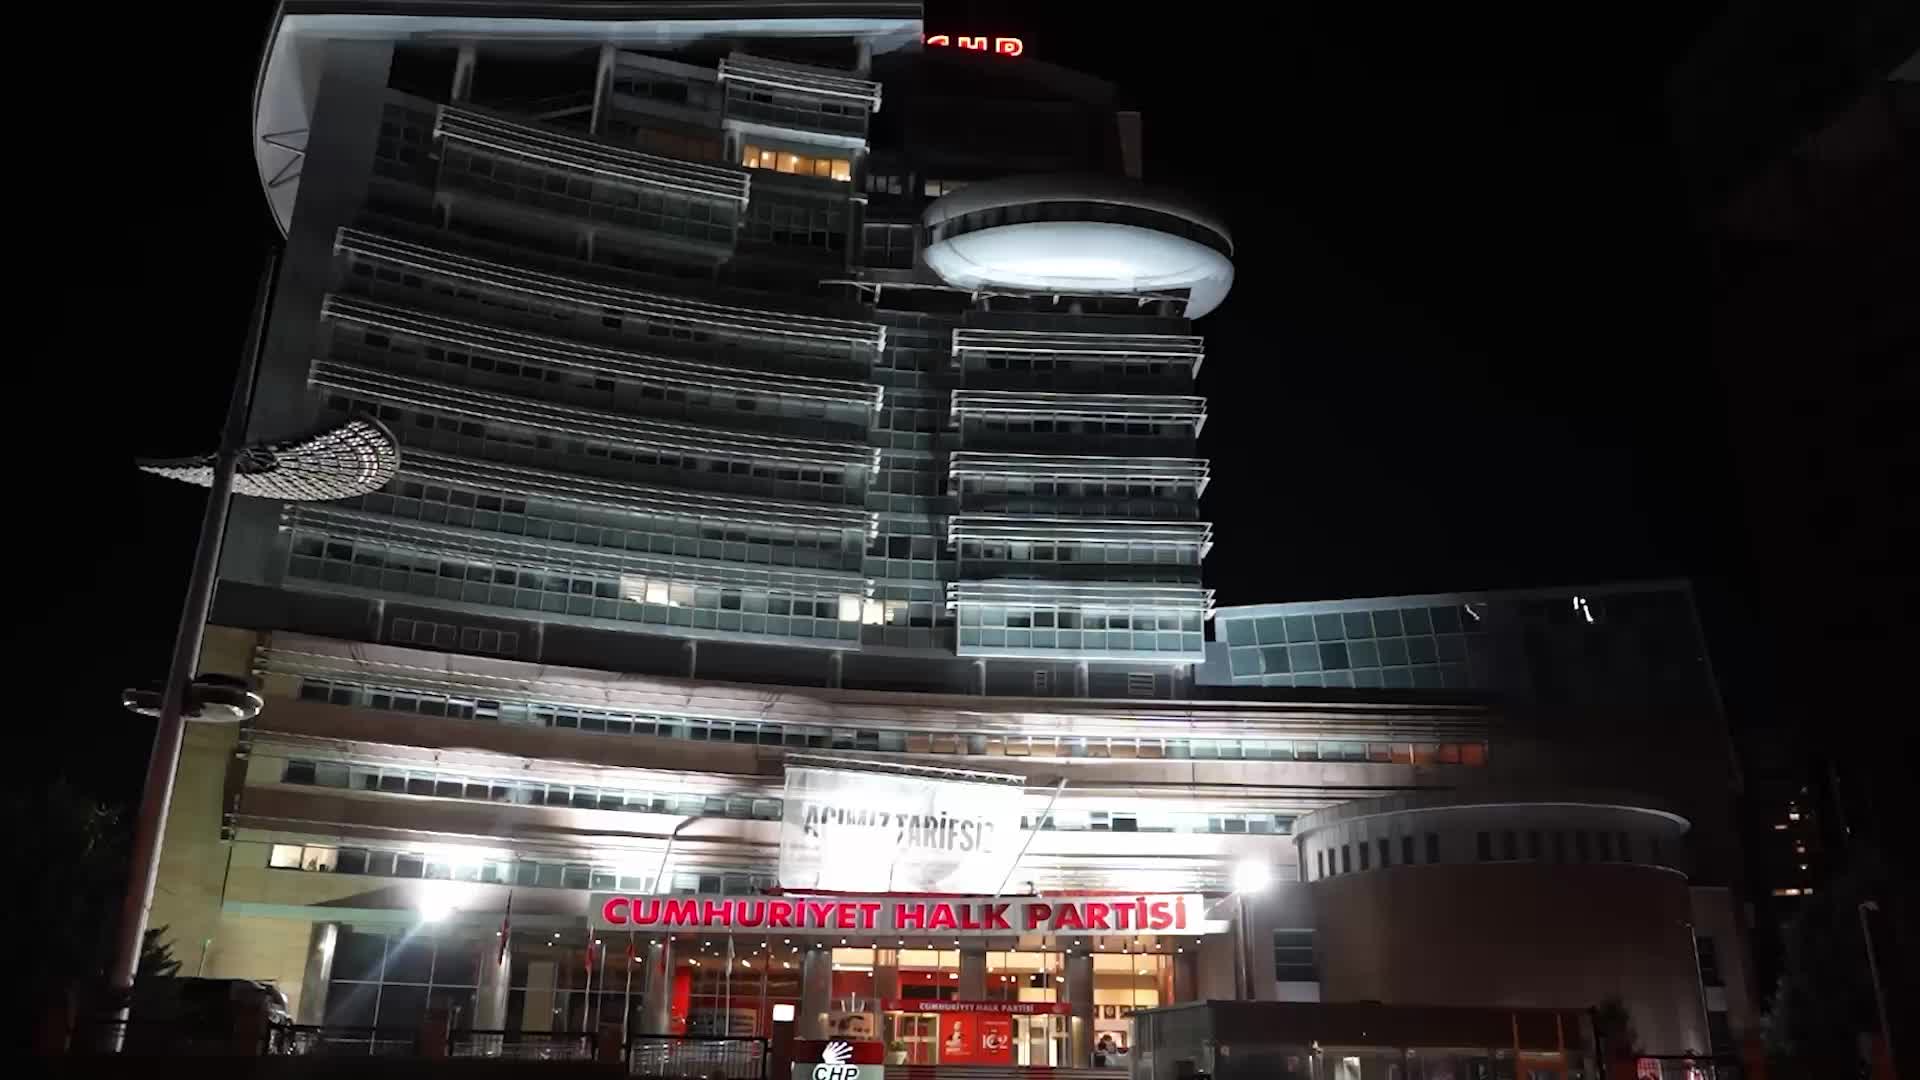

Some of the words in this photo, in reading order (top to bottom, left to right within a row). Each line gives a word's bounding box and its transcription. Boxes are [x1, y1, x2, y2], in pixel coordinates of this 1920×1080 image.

[602, 896, 882, 929] CUMHURİYET
[896, 902, 1010, 930] HALK
[1026, 896, 1187, 930] PARTİSİ
[814, 1066, 858, 1080] CHP
